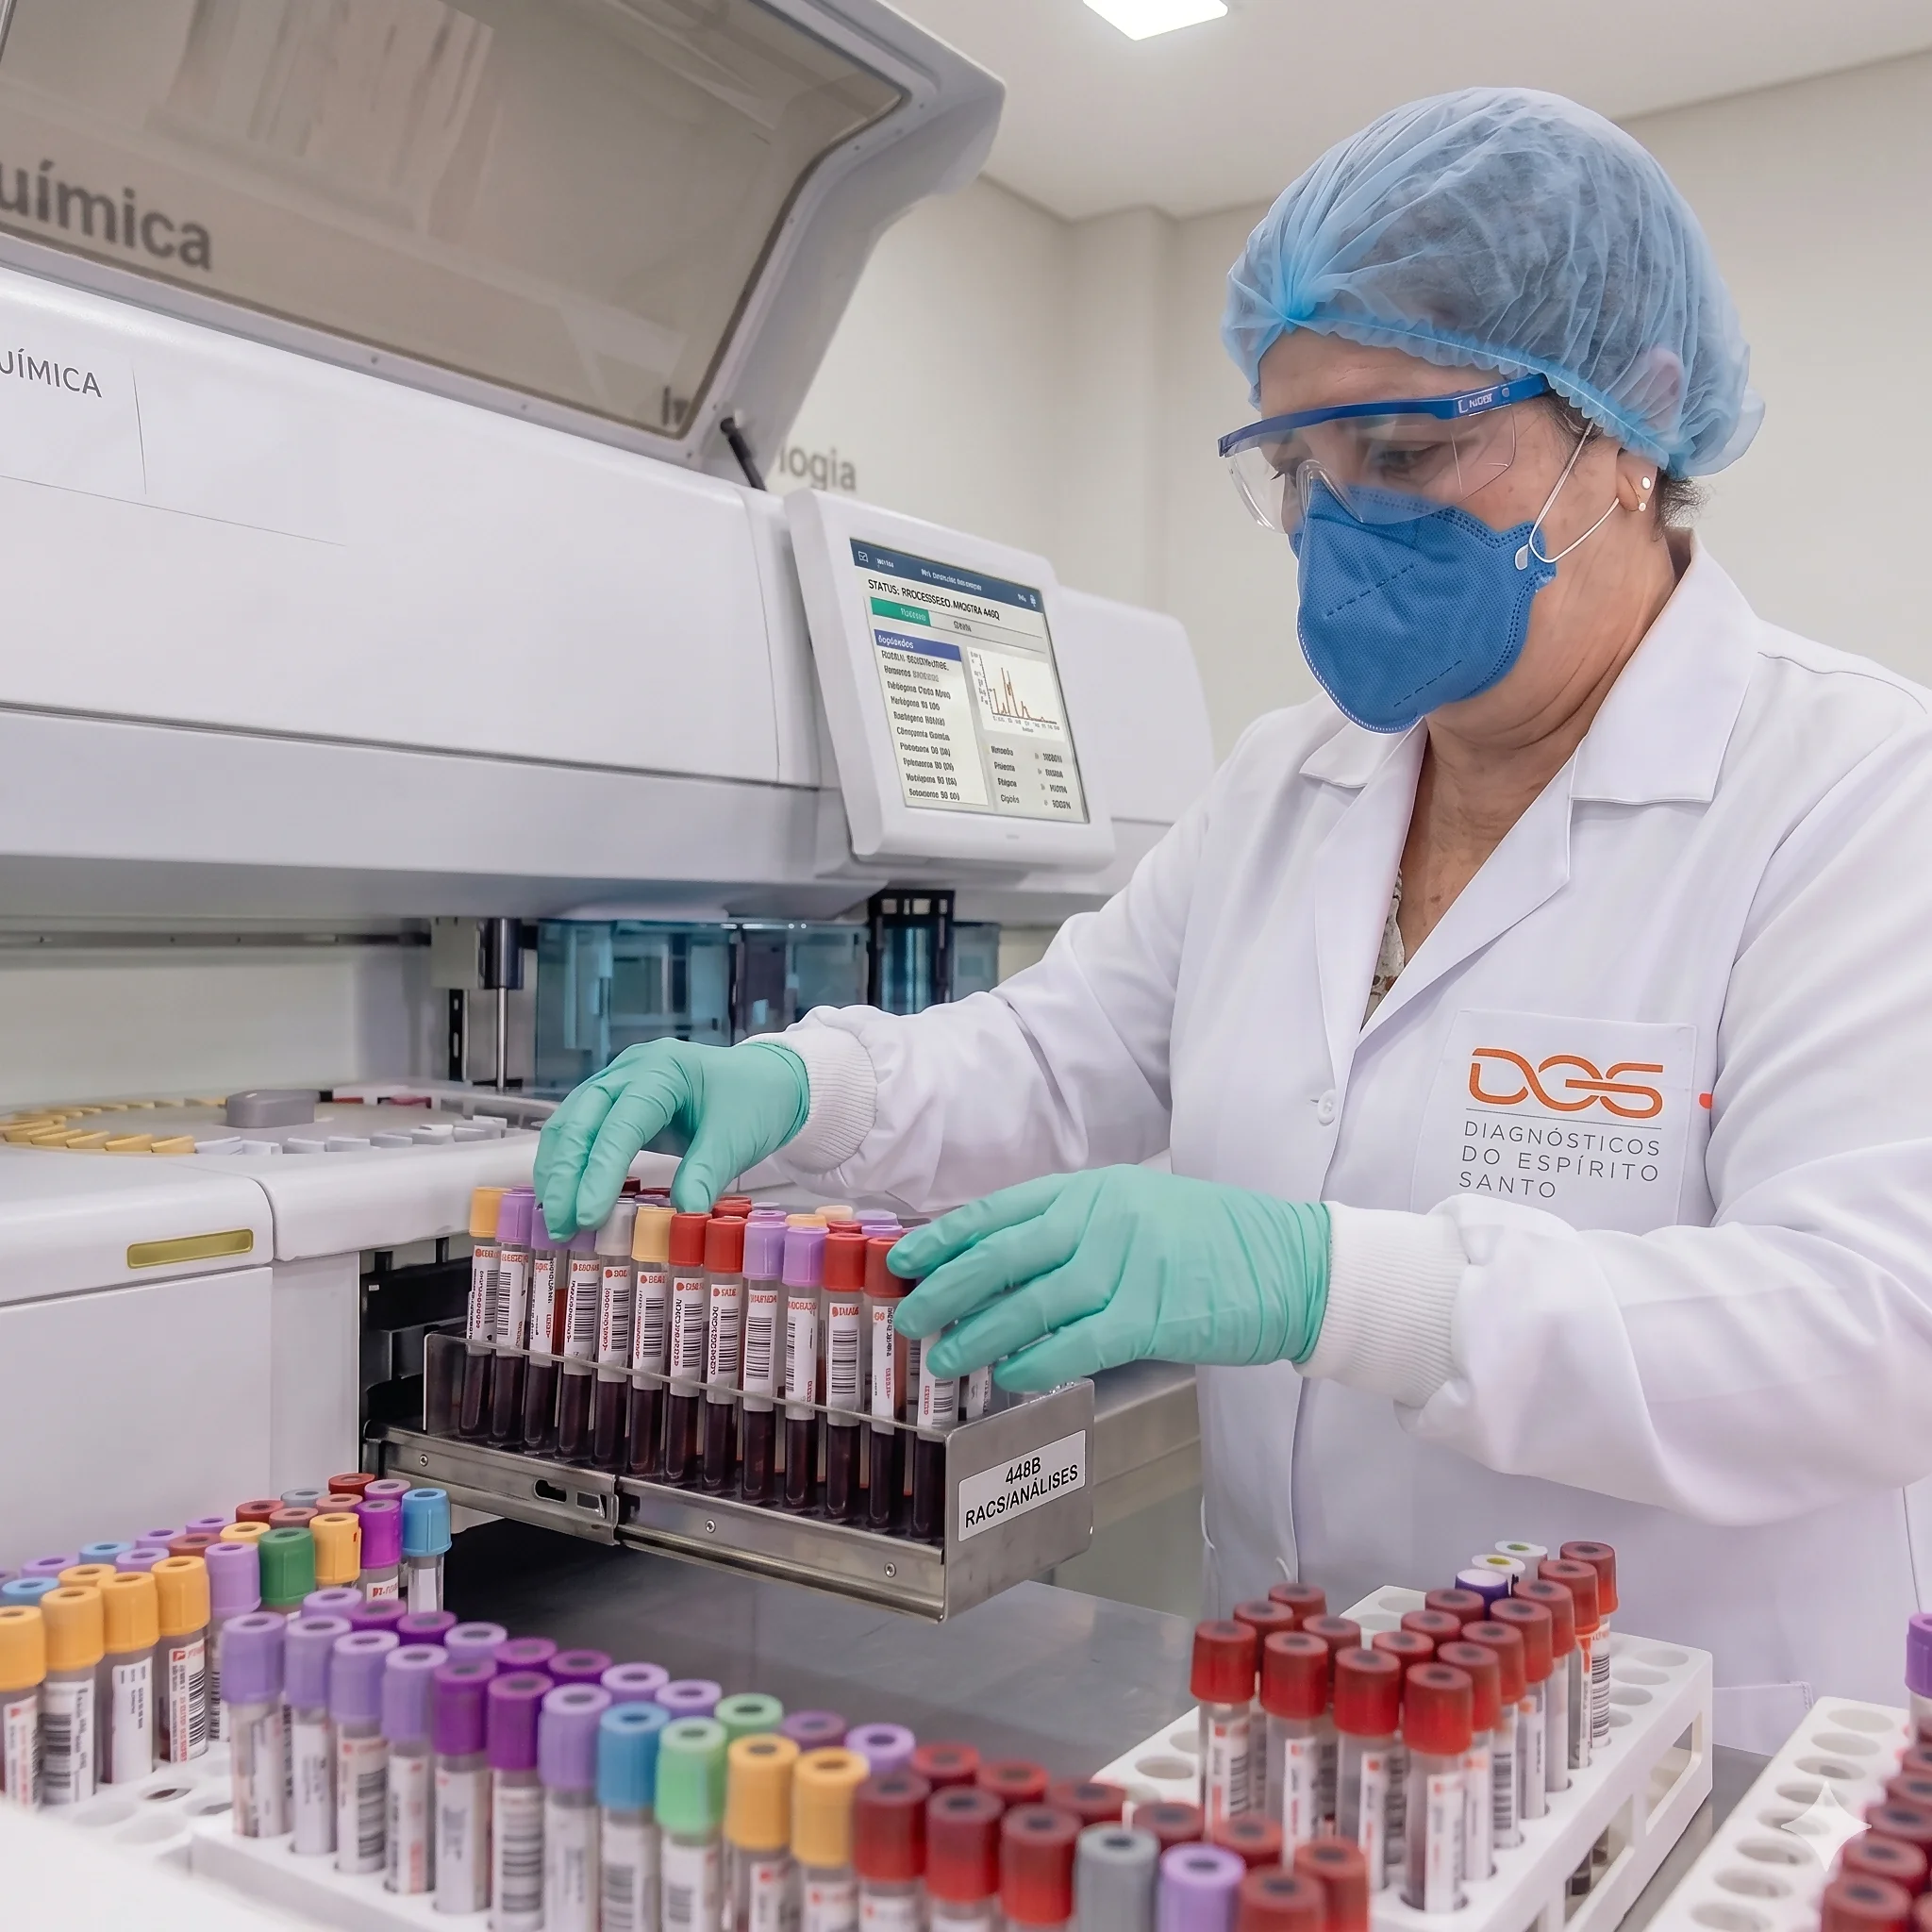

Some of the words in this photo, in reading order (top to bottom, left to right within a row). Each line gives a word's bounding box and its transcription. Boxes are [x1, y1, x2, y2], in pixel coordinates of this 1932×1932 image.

[868, 578, 900, 596] STATUS:
[1465, 1121, 1659, 1157] DIAGNÓSTICOS
[1462, 1145, 1501, 1165] DO
[1518, 1152, 1658, 1182] ESPÍRITO
[1459, 1171, 1556, 1198] SANTO
[1006, 1457, 1041, 1484] 448B
[965, 1464, 1078, 1528] RACS/ANÁLISES
